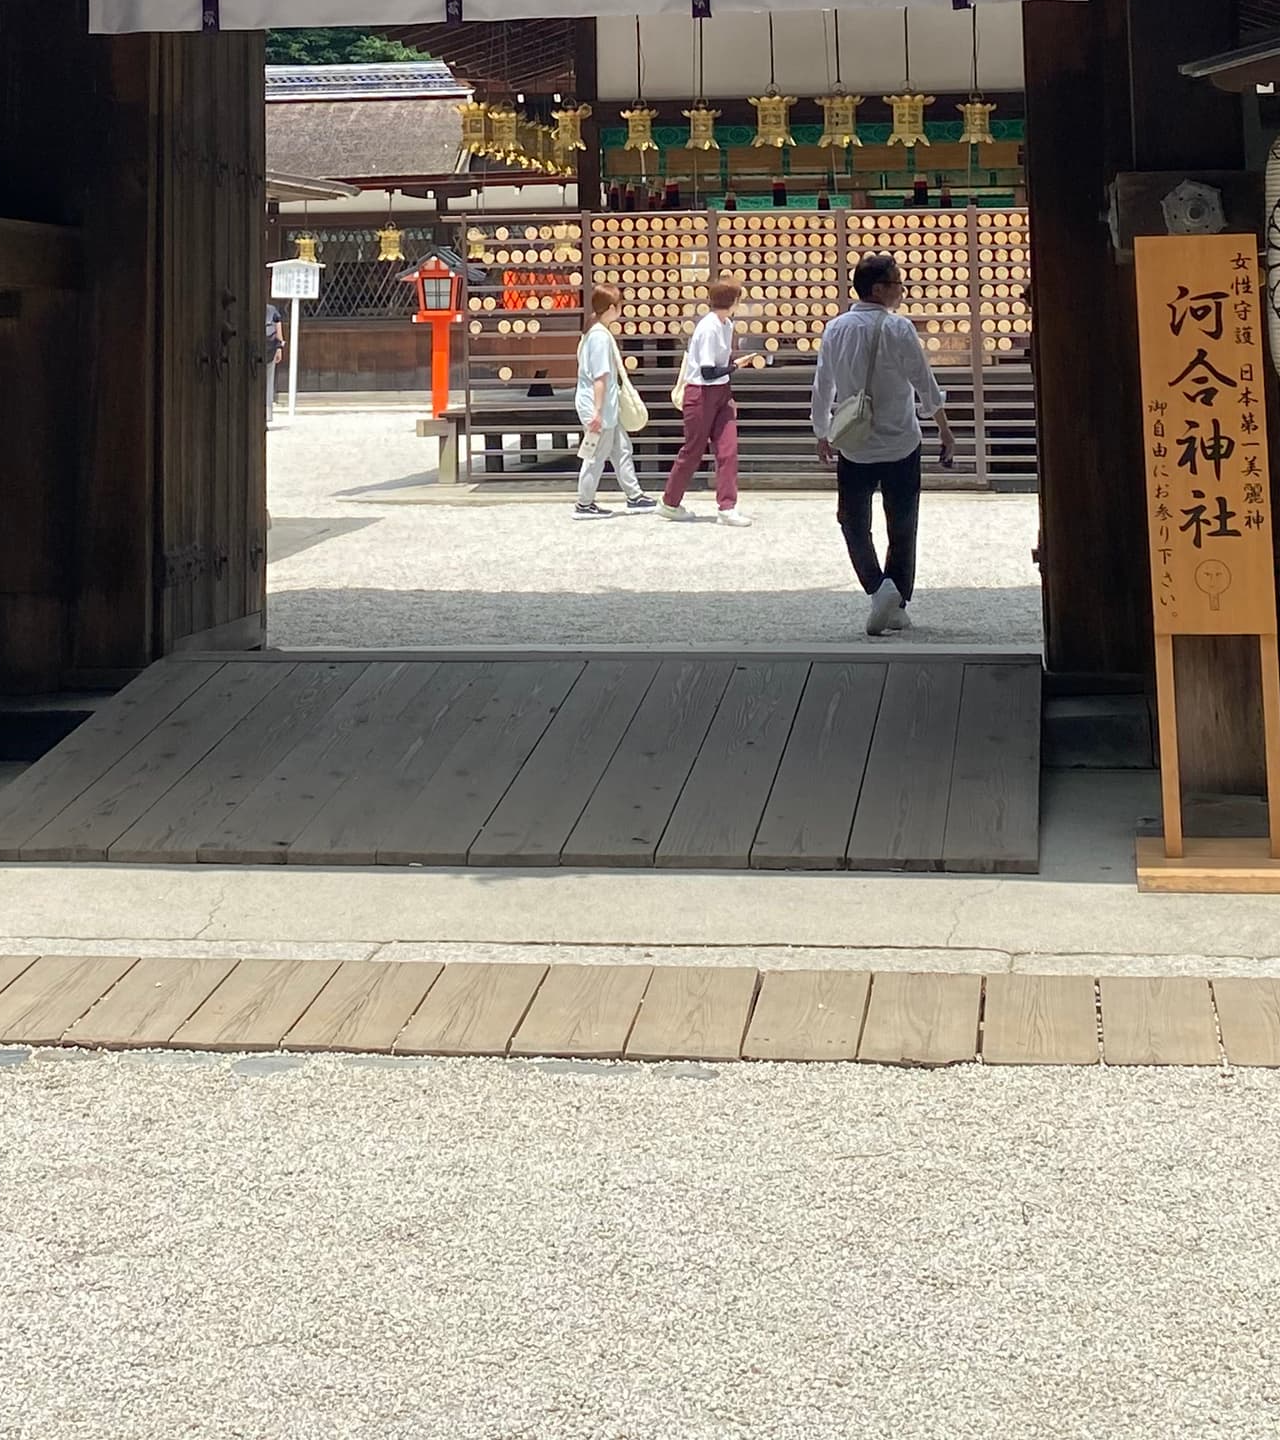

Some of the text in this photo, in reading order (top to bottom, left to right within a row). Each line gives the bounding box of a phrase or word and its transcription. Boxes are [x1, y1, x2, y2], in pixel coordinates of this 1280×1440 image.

[1148, 400, 1178, 617] 御自由にお参り下さい。
[1167, 285, 1242, 549] 河合神社
[1230, 253, 1264, 531] 女性守護 日本第一美麗神
